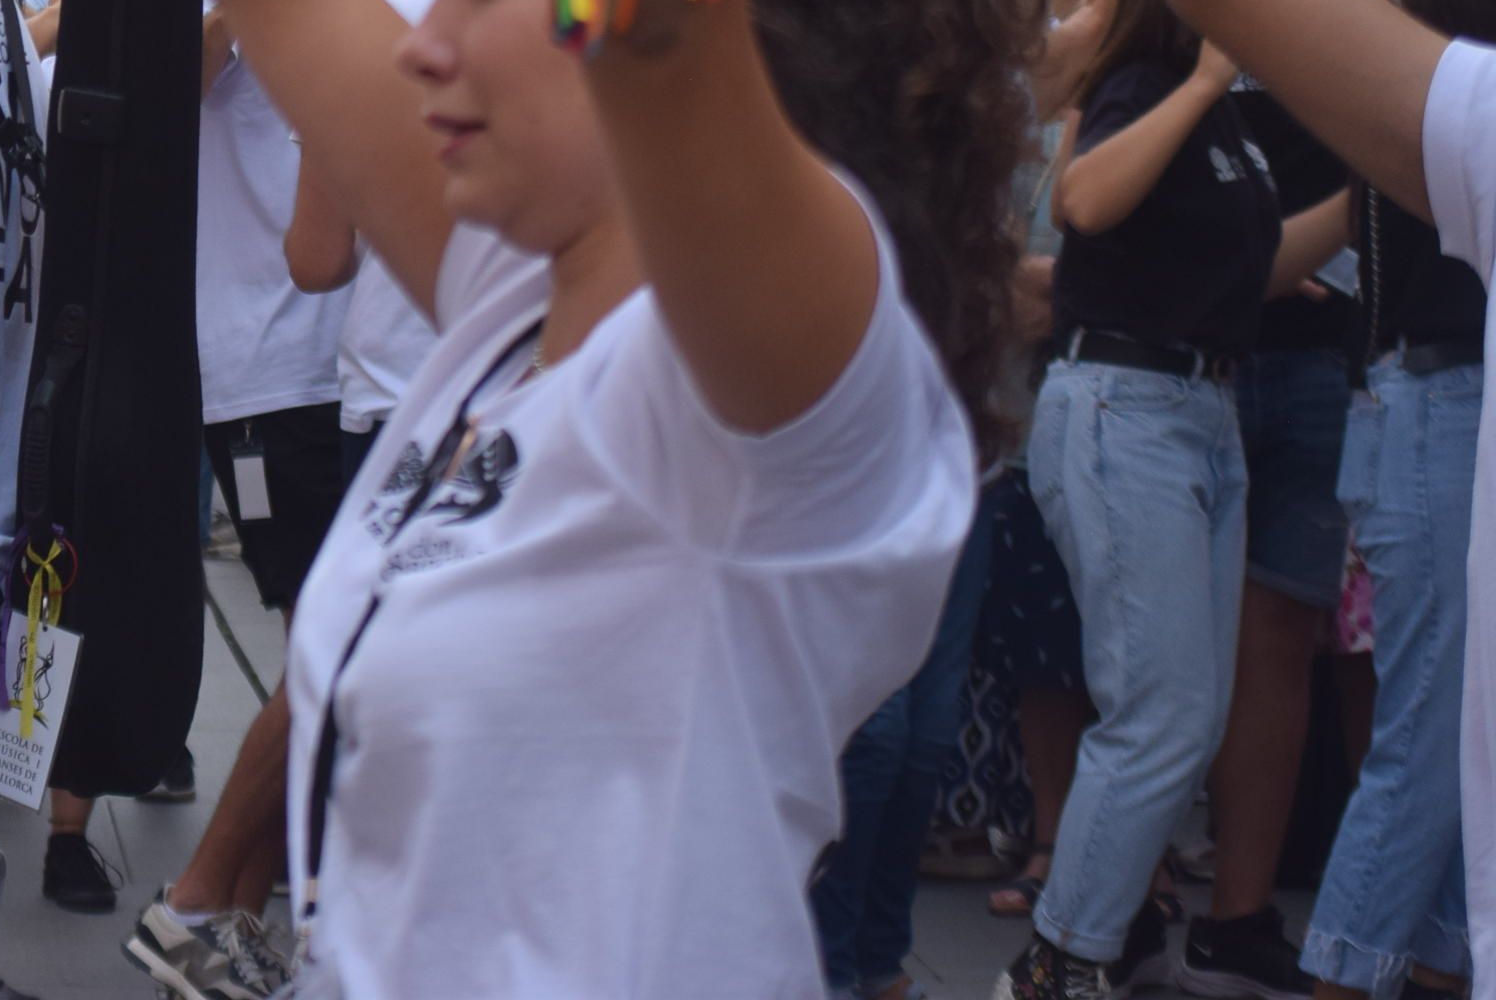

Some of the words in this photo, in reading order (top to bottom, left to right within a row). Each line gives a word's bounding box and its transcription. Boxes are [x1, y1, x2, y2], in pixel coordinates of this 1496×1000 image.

[31, 743, 44, 756] DE
[36, 760, 41, 769] I
[24, 769, 37, 782] DE
